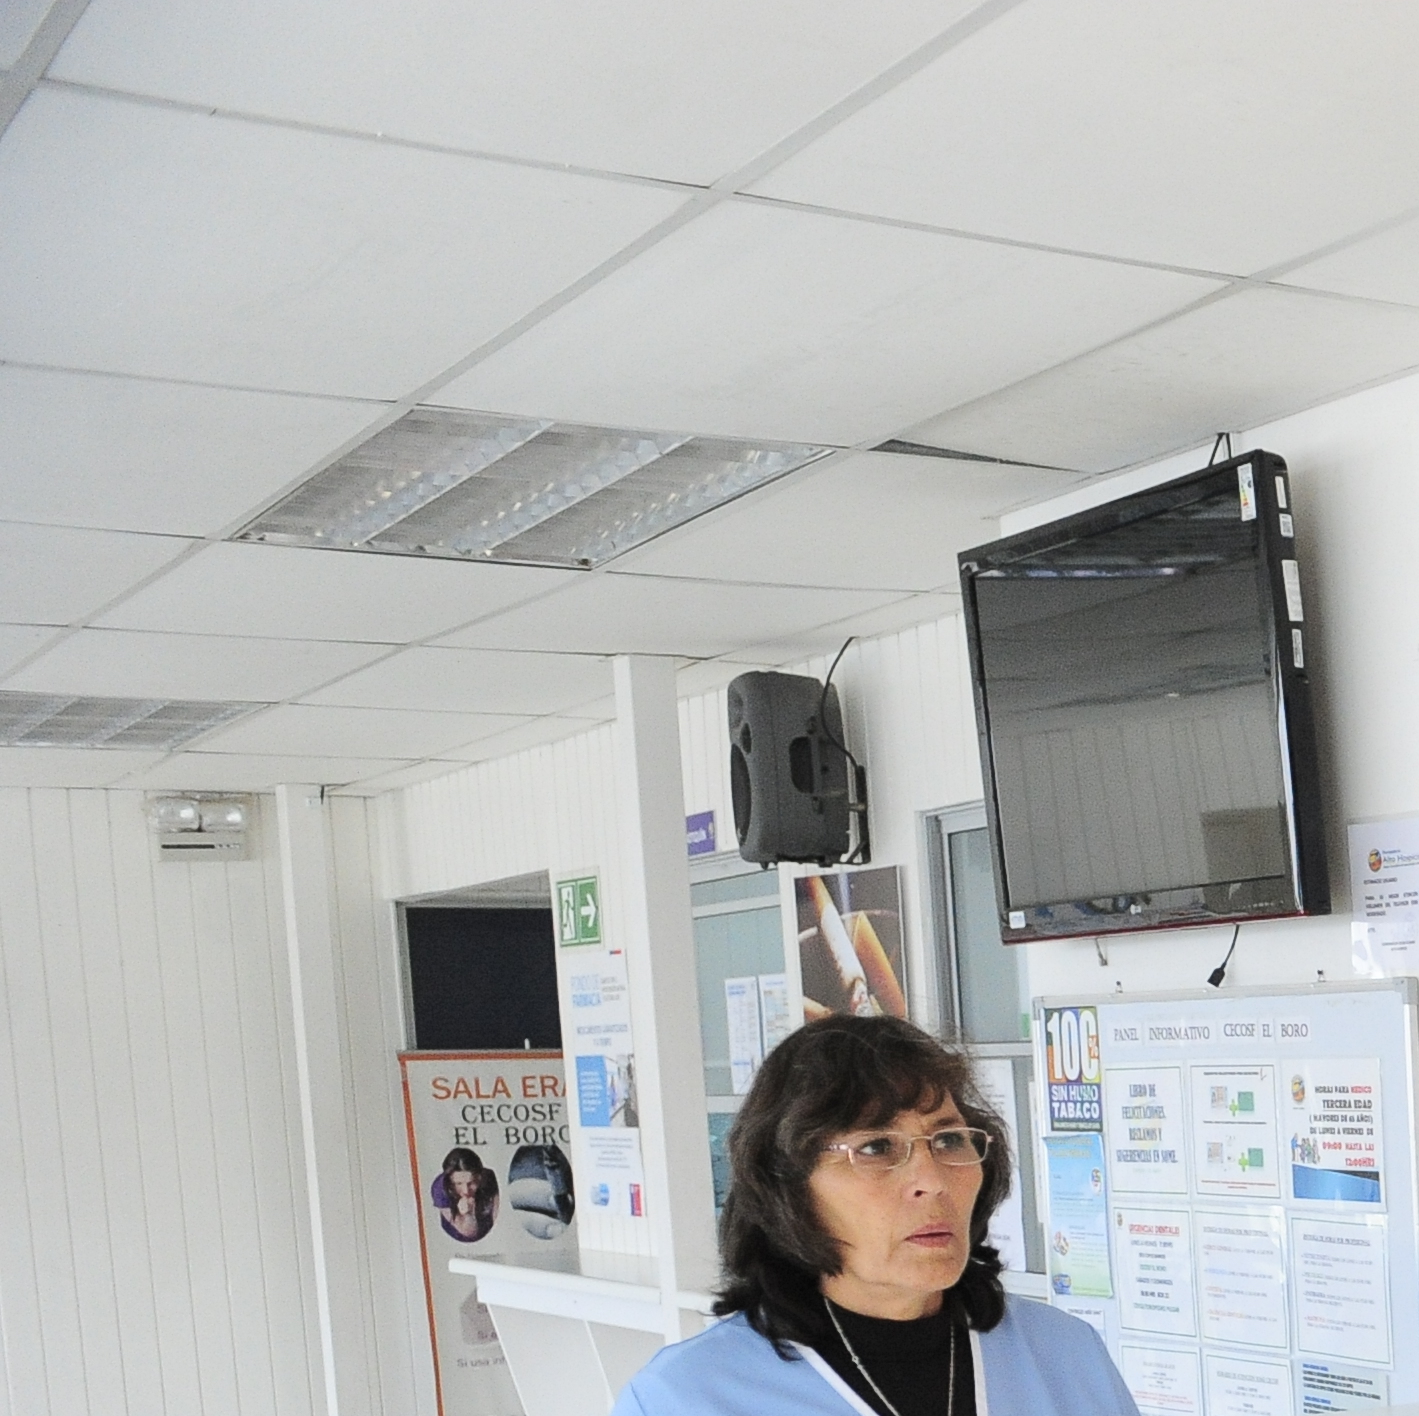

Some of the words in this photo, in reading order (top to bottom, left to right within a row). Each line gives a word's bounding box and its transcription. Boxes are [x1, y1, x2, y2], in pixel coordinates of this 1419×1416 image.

[1114, 1028, 1140, 1041] PANEL
[1149, 1026, 1210, 1041] INFORMATIVO
[1262, 1023, 1272, 1037] EL
[1281, 1023, 1308, 1038] BORO
[431, 1076, 512, 1100] SALA
[1051, 1085, 1067, 1100] SIN
[1069, 1084, 1098, 1100] HUMO
[461, 1103, 561, 1124] CECOSF
[1052, 1102, 1100, 1119] TABACO
[1322, 1100, 1352, 1109] TERCERA
[1354, 1100, 1372, 1109] EDAD
[454, 1126, 487, 1145] EL
